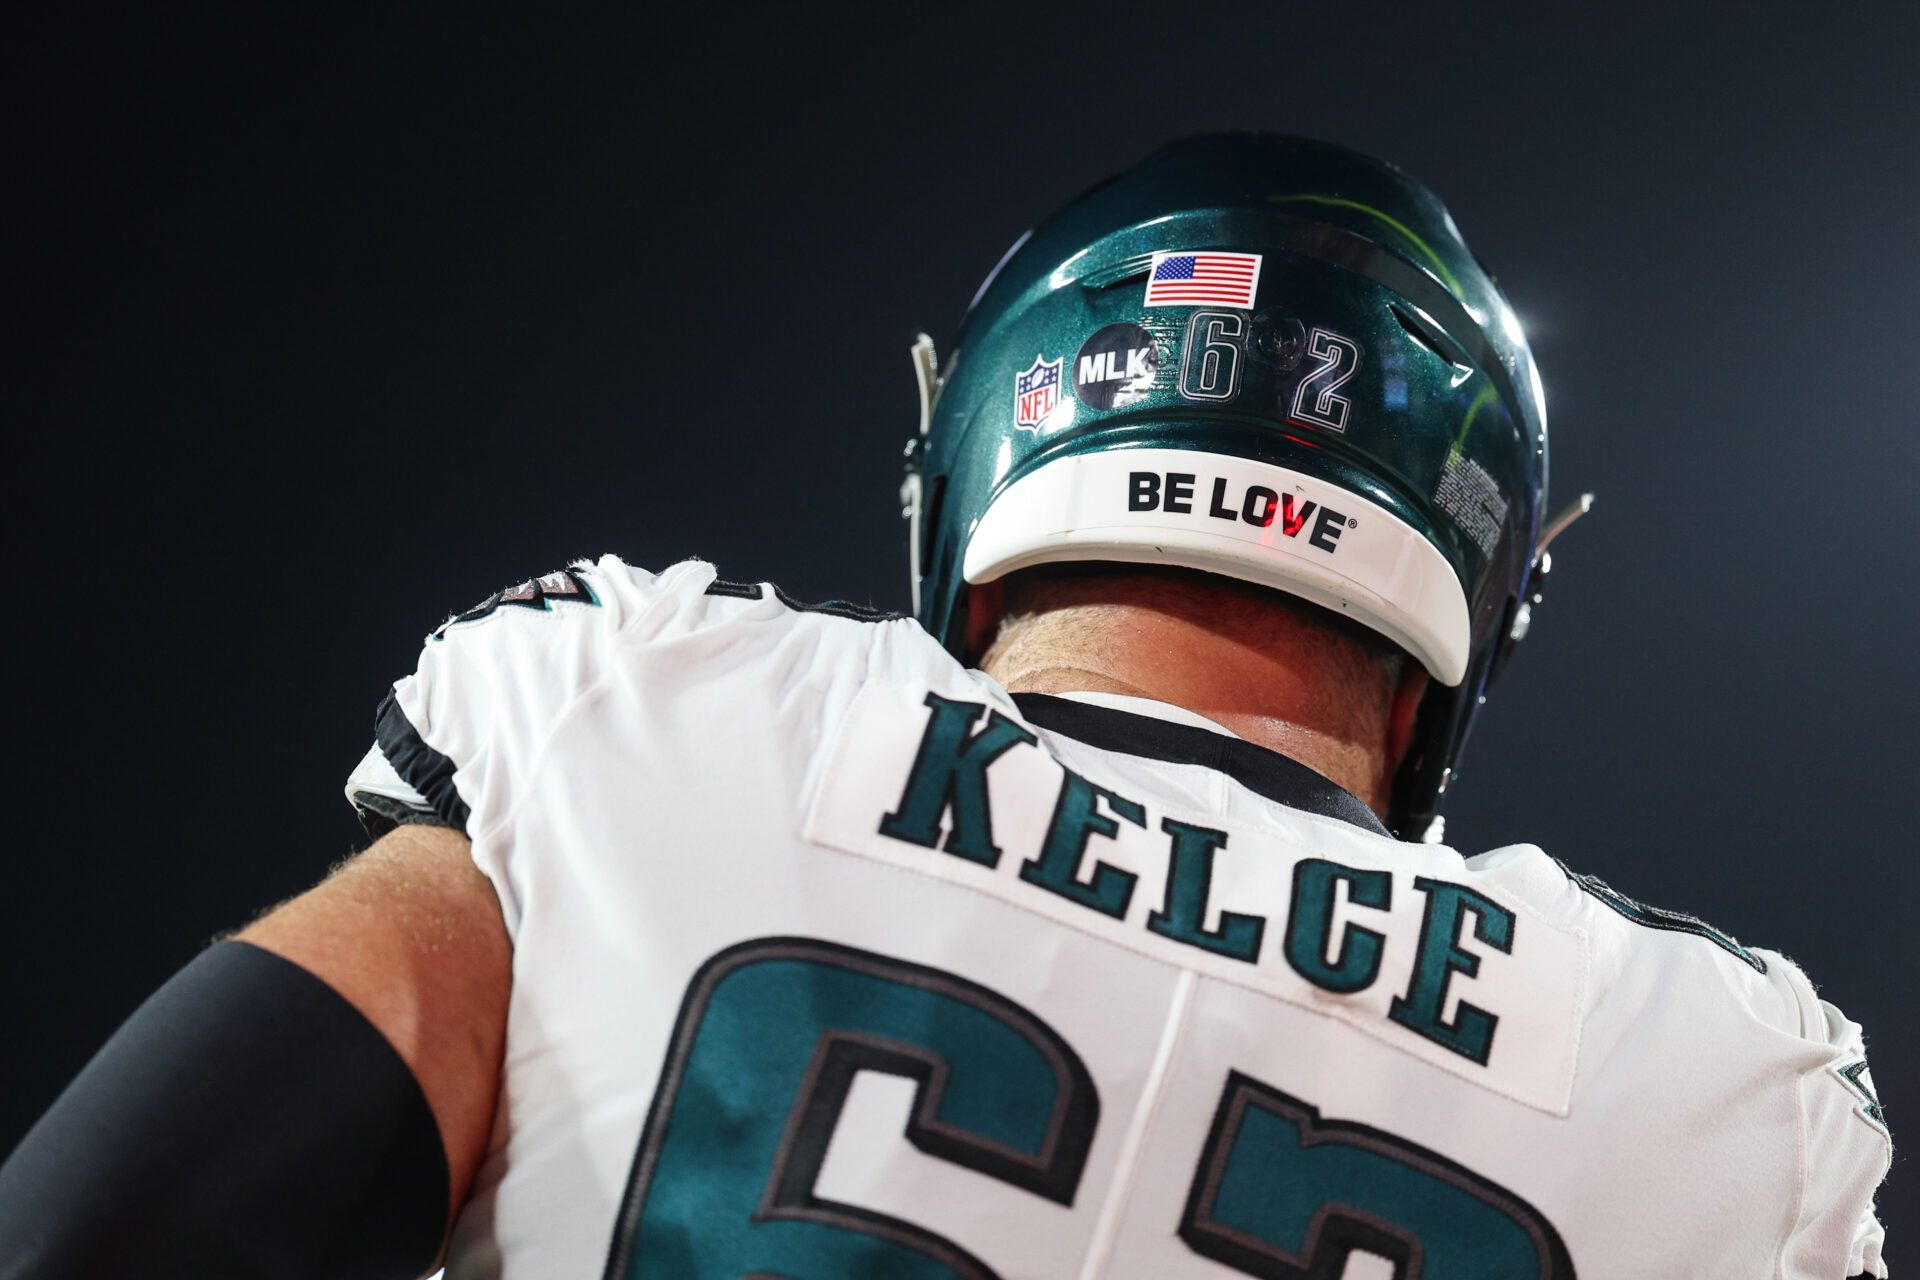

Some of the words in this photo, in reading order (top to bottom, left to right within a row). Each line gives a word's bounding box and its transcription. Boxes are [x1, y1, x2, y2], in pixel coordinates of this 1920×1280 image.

[1078, 347, 1151, 386] MLK
[1020, 387, 1054, 421] NFL
[1128, 471, 1196, 514] BE
[878, 691, 1517, 1068] KELCE
